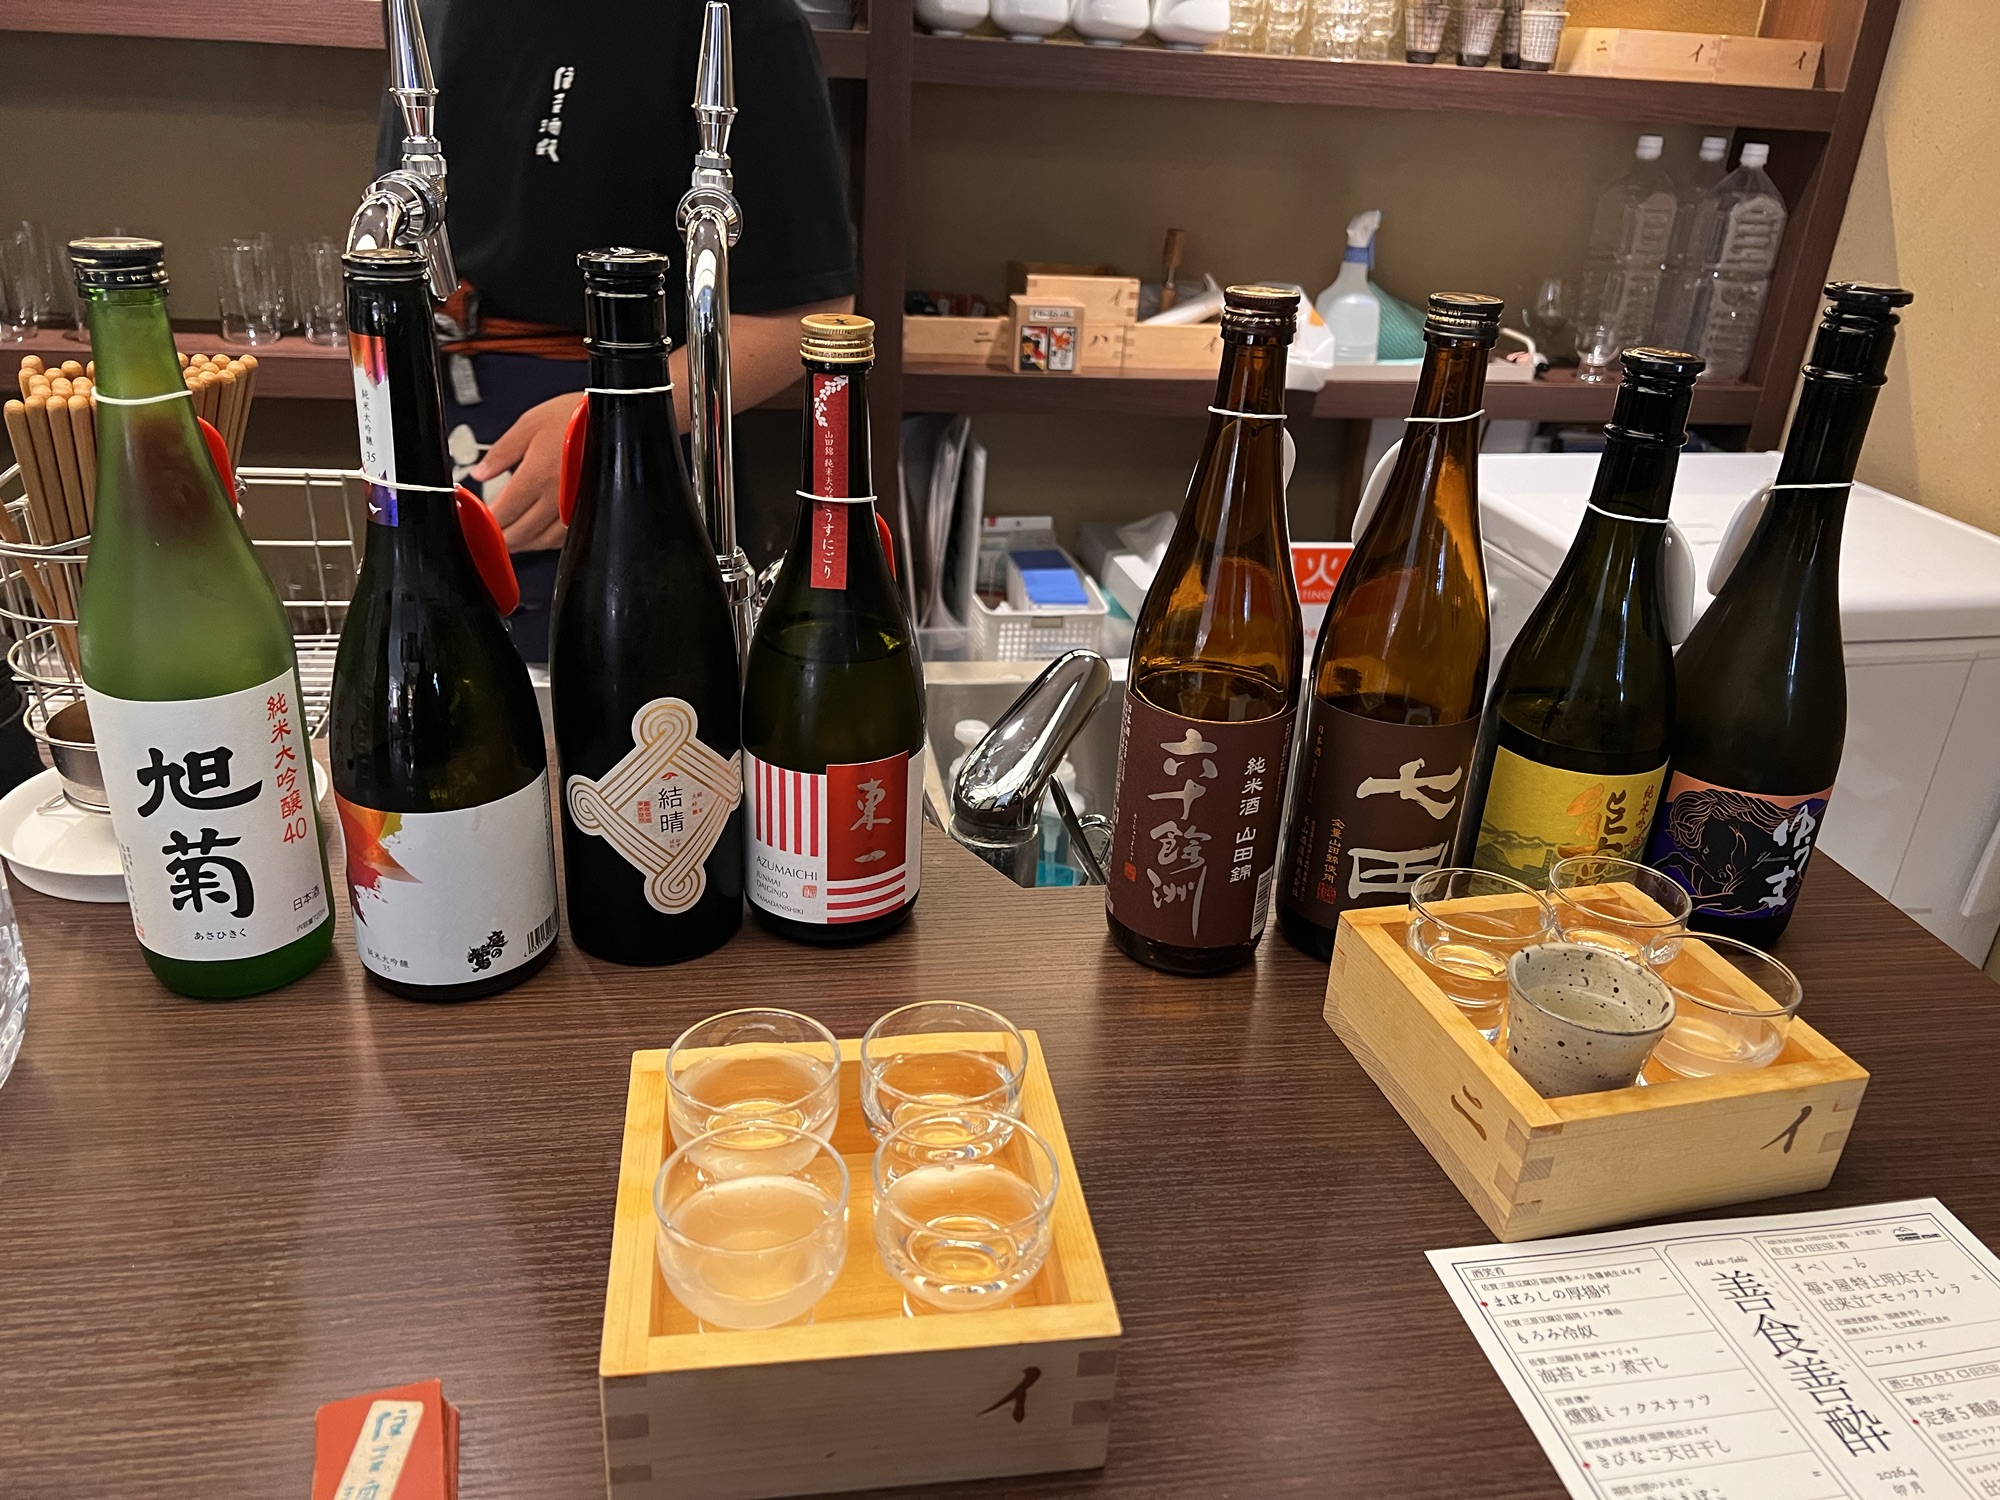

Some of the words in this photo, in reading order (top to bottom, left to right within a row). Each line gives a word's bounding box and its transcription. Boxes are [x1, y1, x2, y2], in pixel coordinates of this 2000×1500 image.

[361, 388, 374, 446] 純米大吟醸
[824, 430, 834, 456] 山田錦
[365, 451, 377, 463] 35
[824, 458, 834, 498] 純米大吟
[821, 508, 835, 580] うすにごり
[1293, 553, 1339, 588] 火
[1239, 756, 1267, 817] 純米酒
[658, 785, 685, 834] 結晴
[849, 777, 893, 864] 東一
[136, 745, 263, 920] 旭菊
[1348, 756, 1464, 900] 七田
[1229, 826, 1257, 884] 山田錦
[1321, 817, 1346, 884] 全量山田錦使用
[756, 855, 818, 881] AZUMAICHI
[756, 869, 781, 887] JUNMAI
[293, 884, 320, 912] 日本酒
[756, 879, 789, 899] DAIGINJO
[756, 892, 804, 915] YAMADANISHIKI
[194, 928, 247, 941] あさひきく
[382, 963, 392, 973] 35
[1695, 1255, 1749, 1269] Field-to-Table
[1771, 1247, 1794, 1256] 住吉
[1794, 1242, 1838, 1253] CHEESE
[1471, 1267, 1505, 1278] 酒笑肴
[1803, 1269, 1939, 1299] 福さ屋特上明太子と
[1495, 1284, 1610, 1307] まぼろしの厚揚げ
[1818, 1284, 1960, 1312] 出来立てモッツァレラ
[1517, 1325, 1598, 1344] もろみ冷奴
[1865, 1340, 1927, 1355] ハーフサイズ
[1536, 1357, 1668, 1384] 海苔とエソ煮干し
[1711, 1269, 1893, 1458] 善食善酔
[1887, 1370, 1955, 1391] 酒に合う合う
[1563, 1395, 1710, 1426] 燻製ミックスナッツ
[1596, 1440, 1731, 1469] きびなご天日干し
[1876, 1466, 1919, 1481] 2026.4
